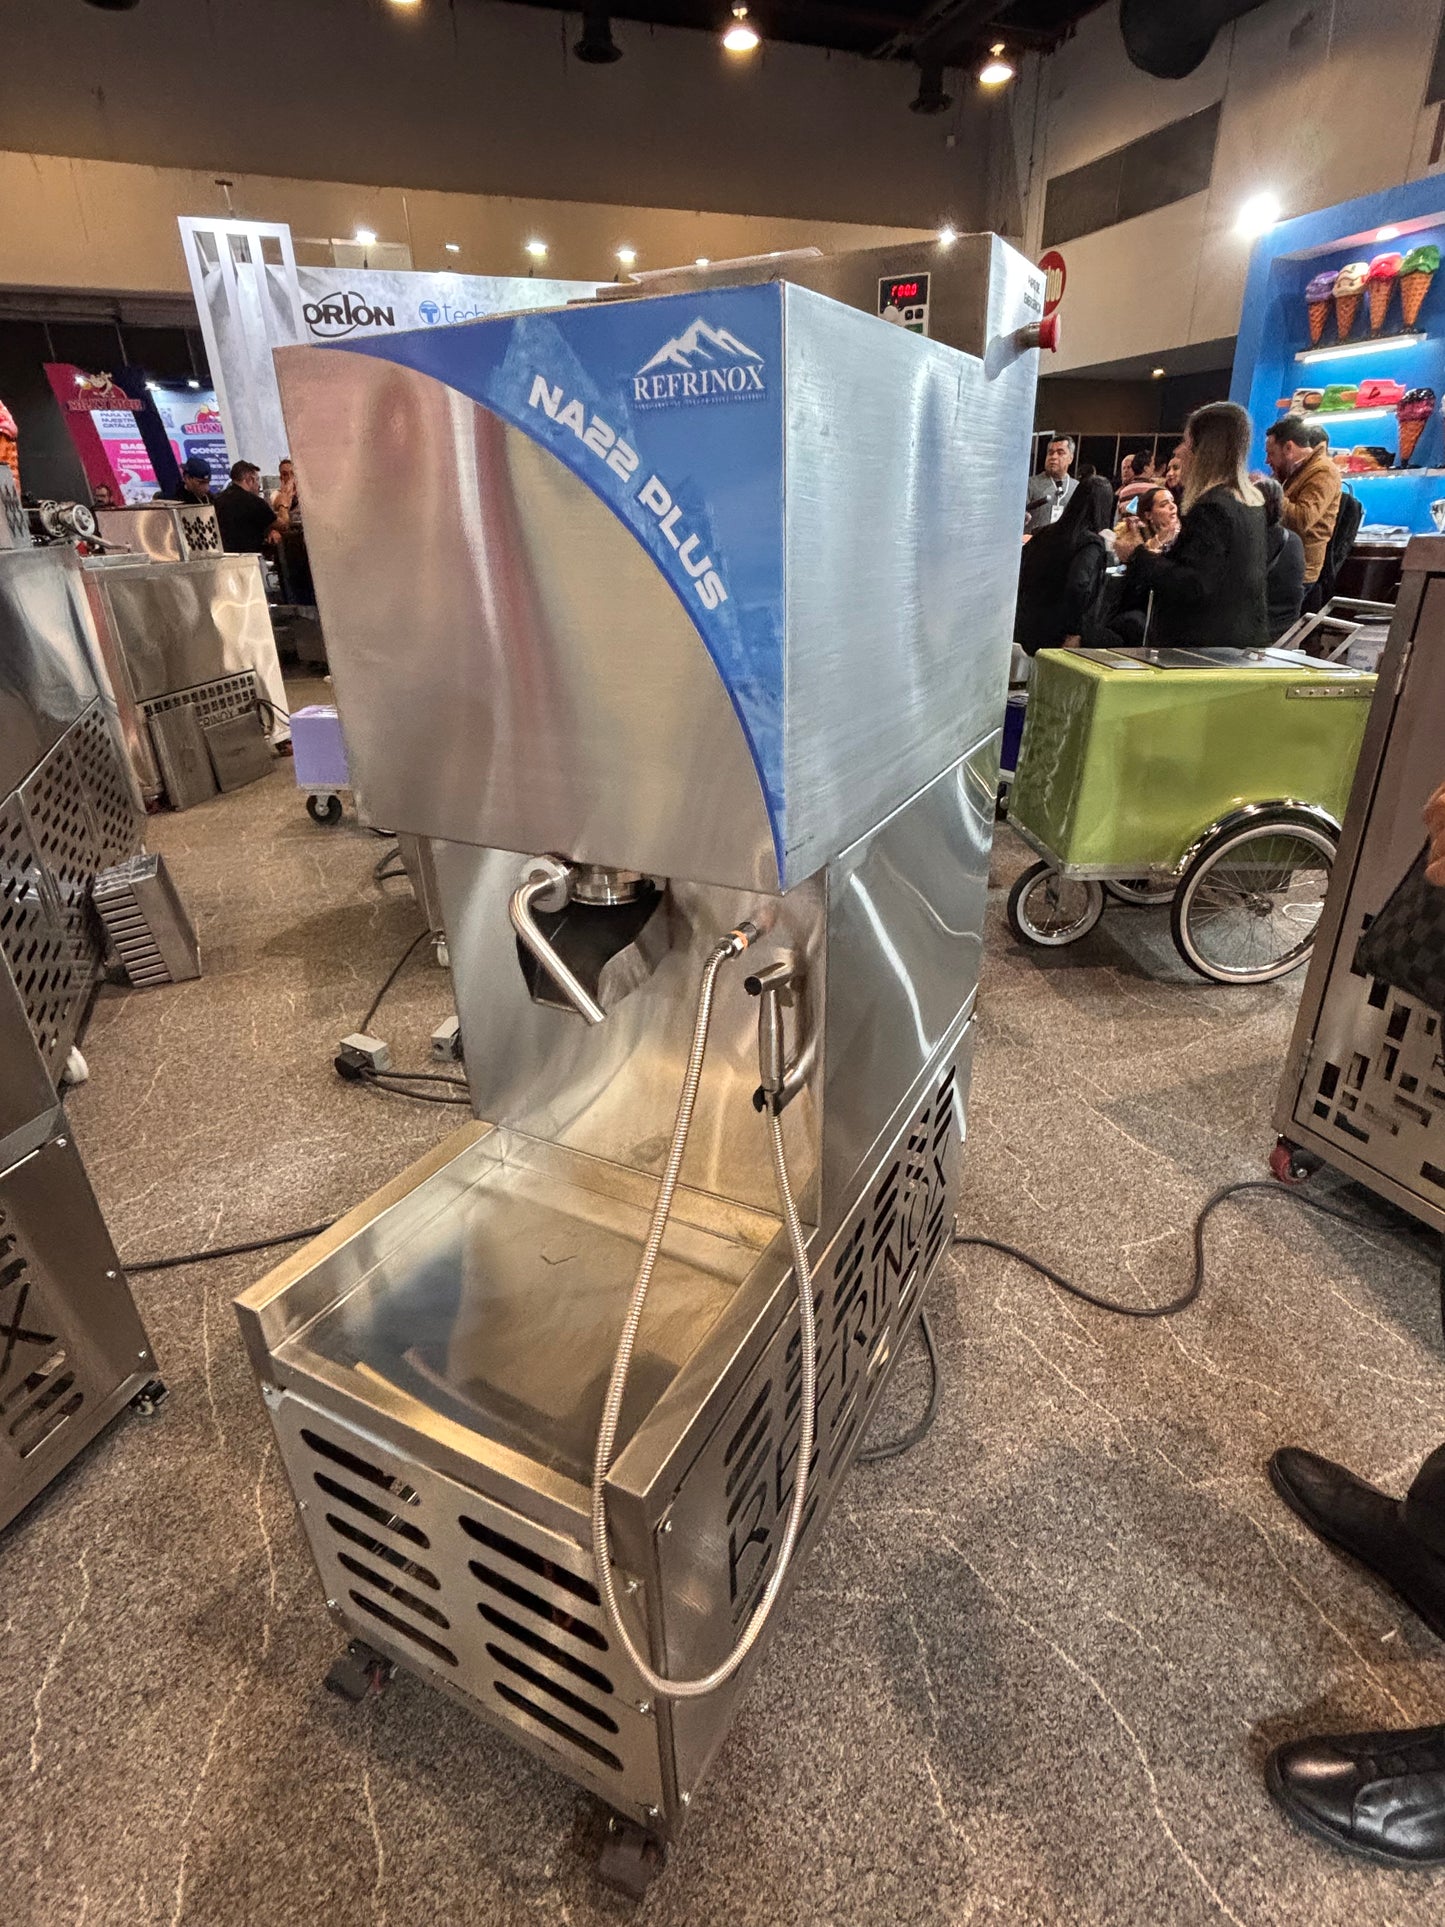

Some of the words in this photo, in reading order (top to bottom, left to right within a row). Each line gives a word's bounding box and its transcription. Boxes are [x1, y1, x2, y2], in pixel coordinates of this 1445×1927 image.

[303, 294, 395, 327] ORION
[632, 365, 765, 400] REFRINOX
[528, 375, 640, 483] NA22
[638, 475, 727, 610] PLUS
[727, 1132, 949, 1604] REFRINOX
